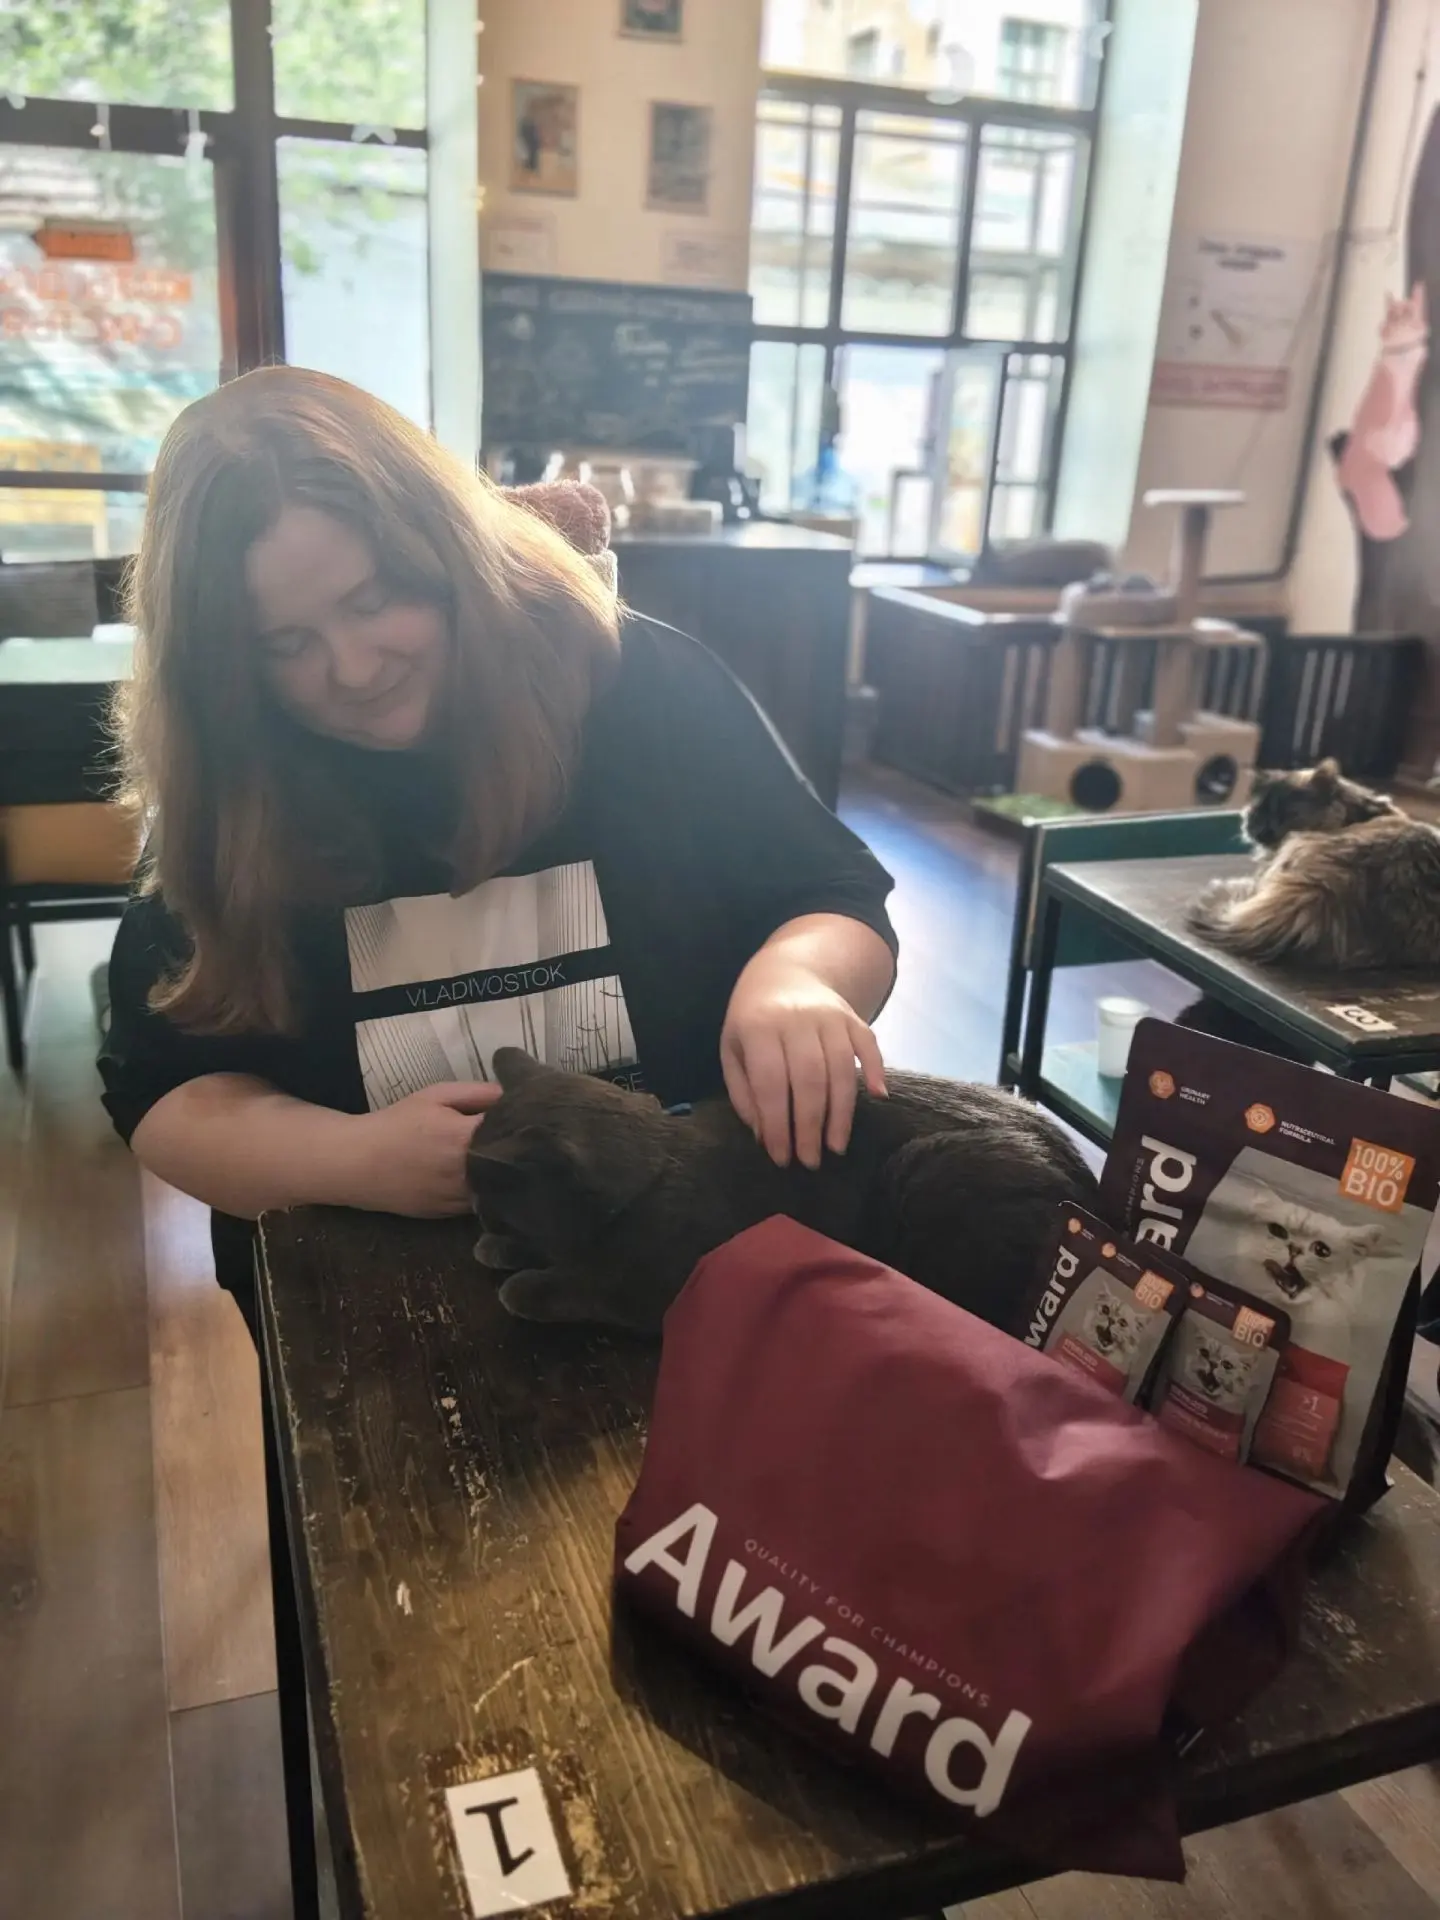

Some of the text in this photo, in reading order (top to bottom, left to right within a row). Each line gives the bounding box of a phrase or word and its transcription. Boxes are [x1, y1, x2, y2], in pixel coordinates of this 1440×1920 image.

[407, 963, 566, 1007] VLADIVOSTOK
[1133, 1134, 1198, 1252] ard
[1344, 1167, 1398, 1207] BIO
[1353, 1144, 1406, 1181] 100%
[1024, 1244, 1080, 1348] ward
[1135, 1286, 1162, 1309] BIO
[1233, 1325, 1265, 1348] BIO
[744, 1538, 992, 1709] QUALITY FOR CHAMPIONS
[624, 1502, 1033, 1818] Award
[465, 1796, 535, 1878] 1
